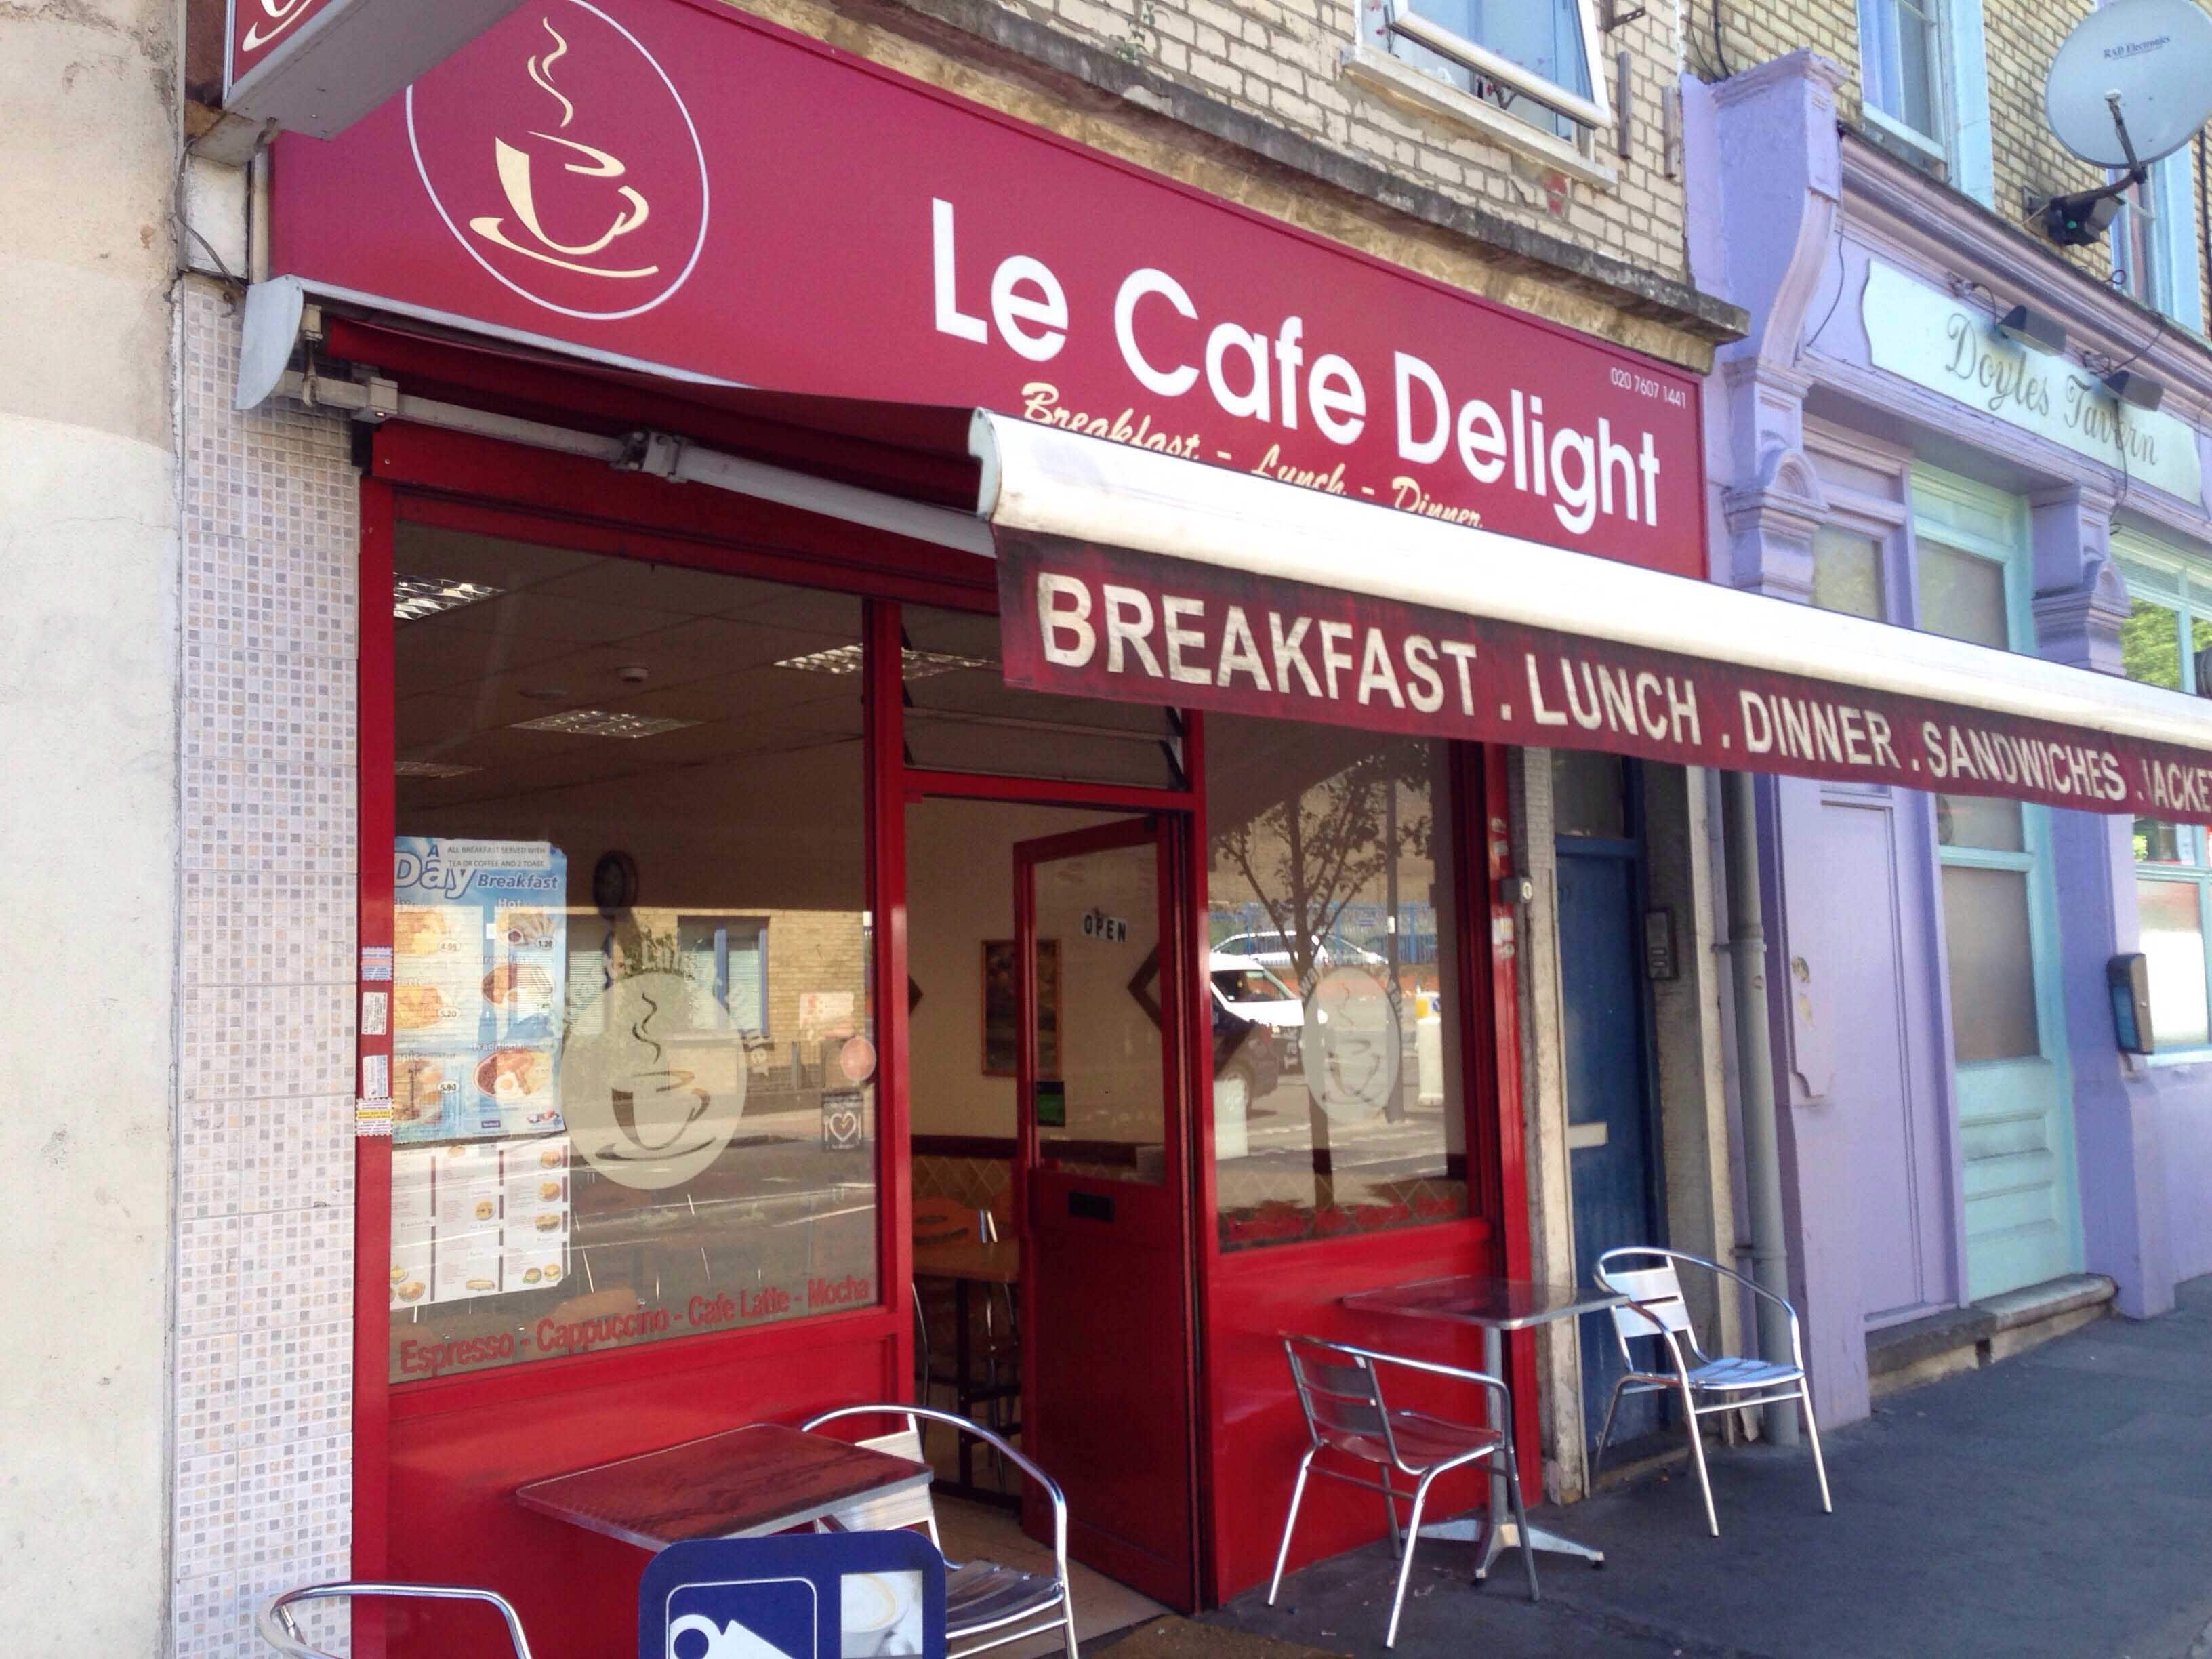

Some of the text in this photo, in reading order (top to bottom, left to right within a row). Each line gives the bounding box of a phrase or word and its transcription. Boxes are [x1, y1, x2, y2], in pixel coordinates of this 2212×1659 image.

[933, 197, 1660, 535] Le Cafe Delight
[1610, 367, 1686, 409] 020 7607 1441
[1946, 312, 2049, 417] Doyles
[1037, 571, 1476, 716] BREAKFAST
[1525, 653, 1701, 745] LUNCH
[1739, 690, 1900, 769] DINNER
[1923, 721, 2127, 801] SANDWICHES
[394, 850, 559, 899] Day Breakfast
[1084, 915, 1126, 943] OPEN
[400, 1333, 515, 1378] Espresso
[536, 1308, 670, 1357] Cappuccino
[688, 1290, 736, 1326] Cafe
[741, 1286, 790, 1318] Latte
[807, 1275, 870, 1307] Mocha
